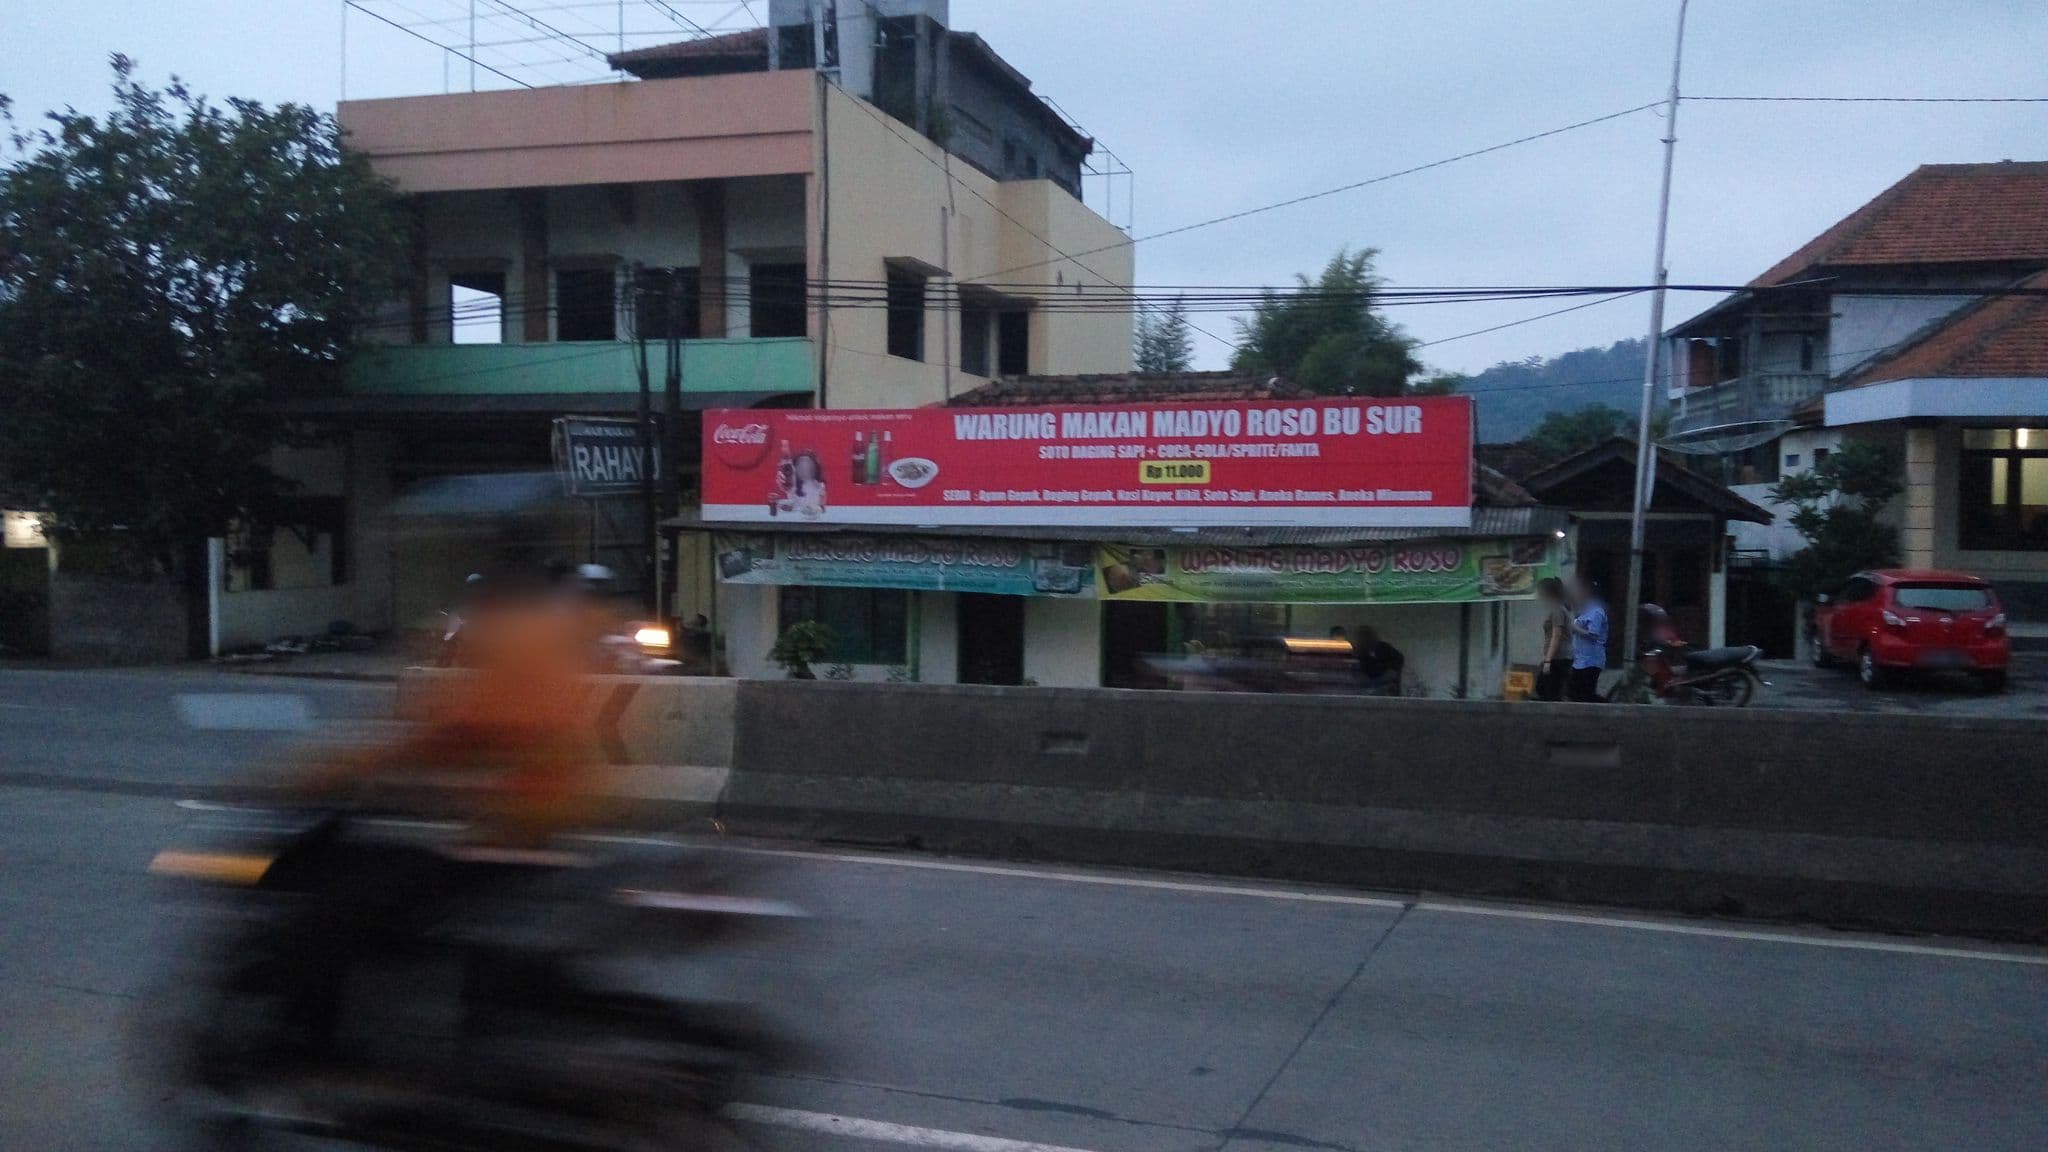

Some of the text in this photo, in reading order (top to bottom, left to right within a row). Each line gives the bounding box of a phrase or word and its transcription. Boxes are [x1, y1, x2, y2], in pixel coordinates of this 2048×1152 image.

[713, 423, 770, 444] Coca-Cola
[953, 405, 1422, 441] WARUNG MAKAN MADYO ROSO BU SUR
[1038, 445, 1070, 459] SOTO
[1117, 444, 1146, 459] SAPI
[1147, 464, 1204, 479] Rp 11.000
[1390, 545, 1461, 573] ROSO
